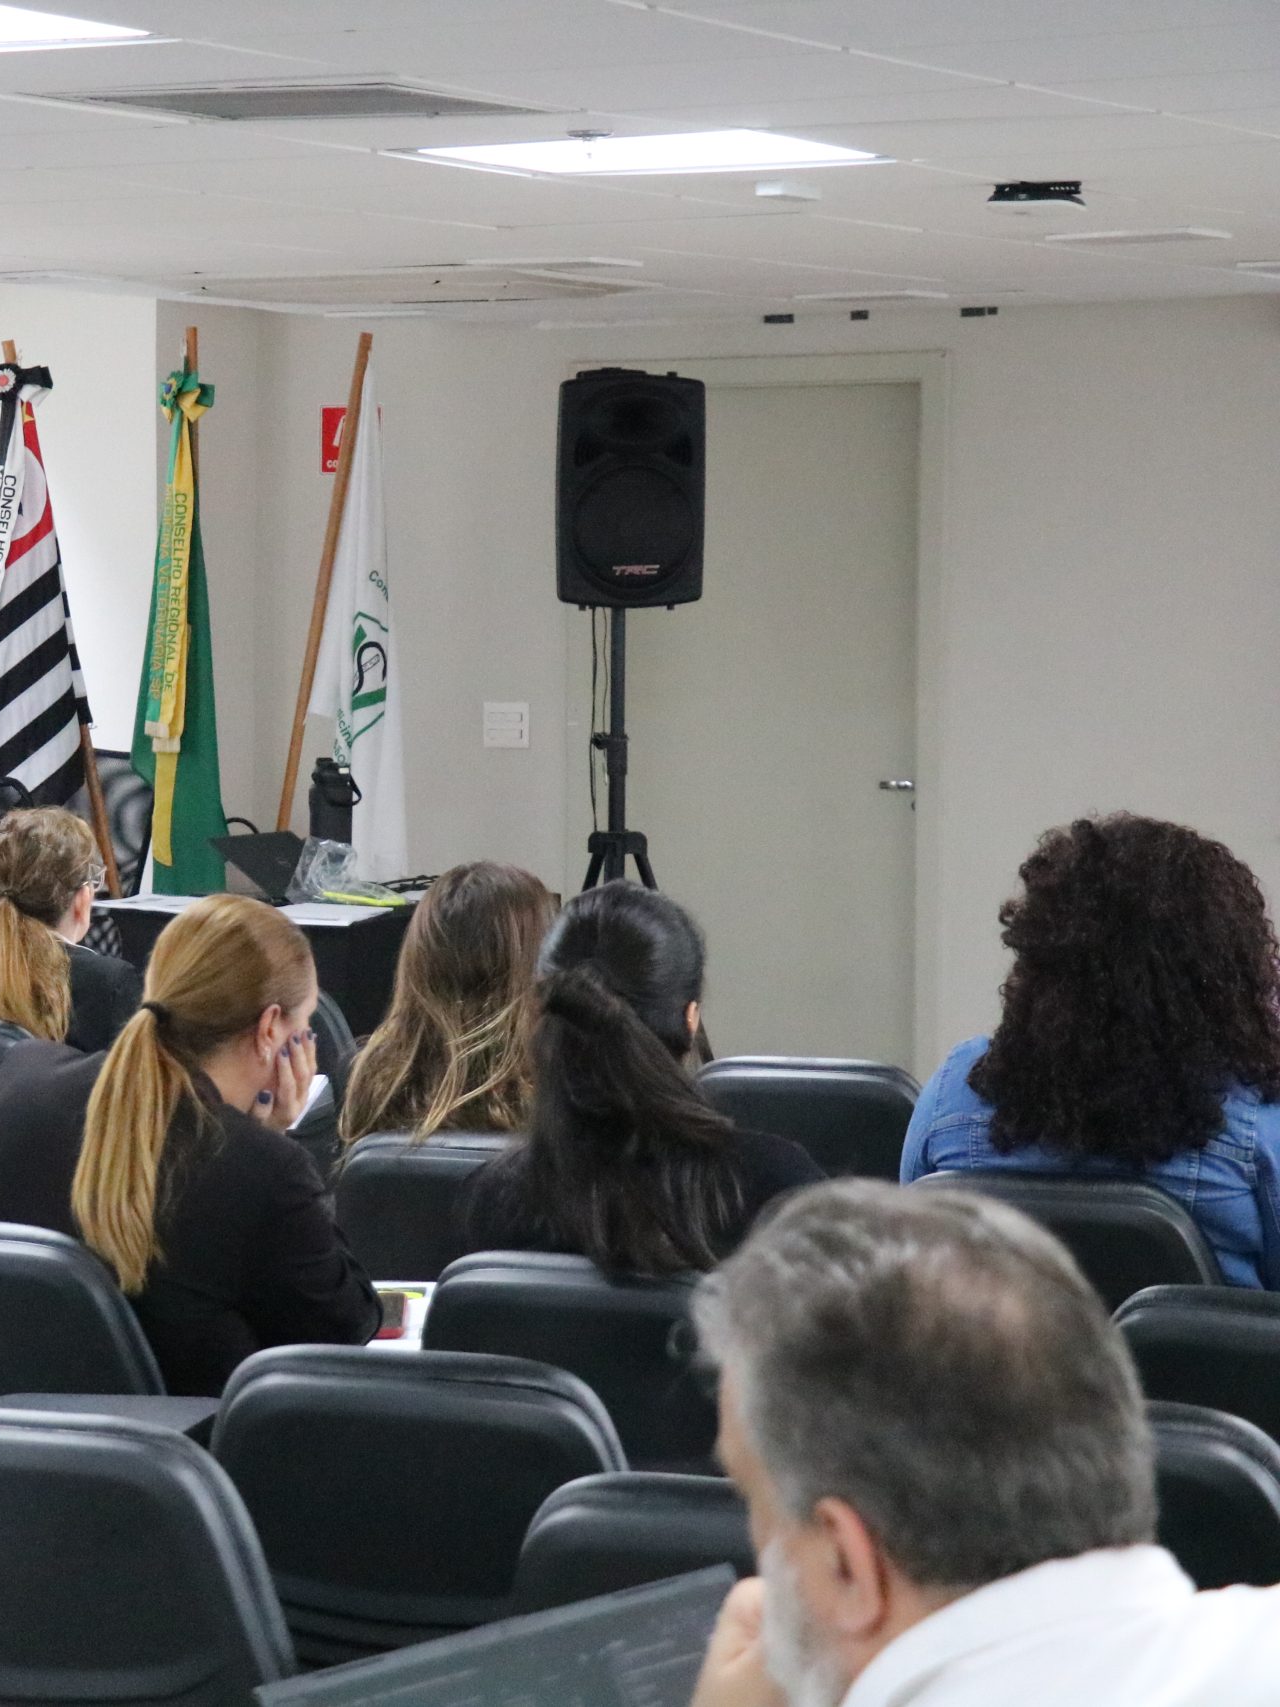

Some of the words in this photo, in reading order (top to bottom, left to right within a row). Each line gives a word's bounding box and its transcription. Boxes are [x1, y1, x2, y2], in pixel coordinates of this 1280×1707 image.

[160, 482, 174, 560] MEDICINA
[171, 492, 187, 579] CONSELHO
[166, 586, 181, 664] REGIONAL
[164, 672, 175, 692] DE
